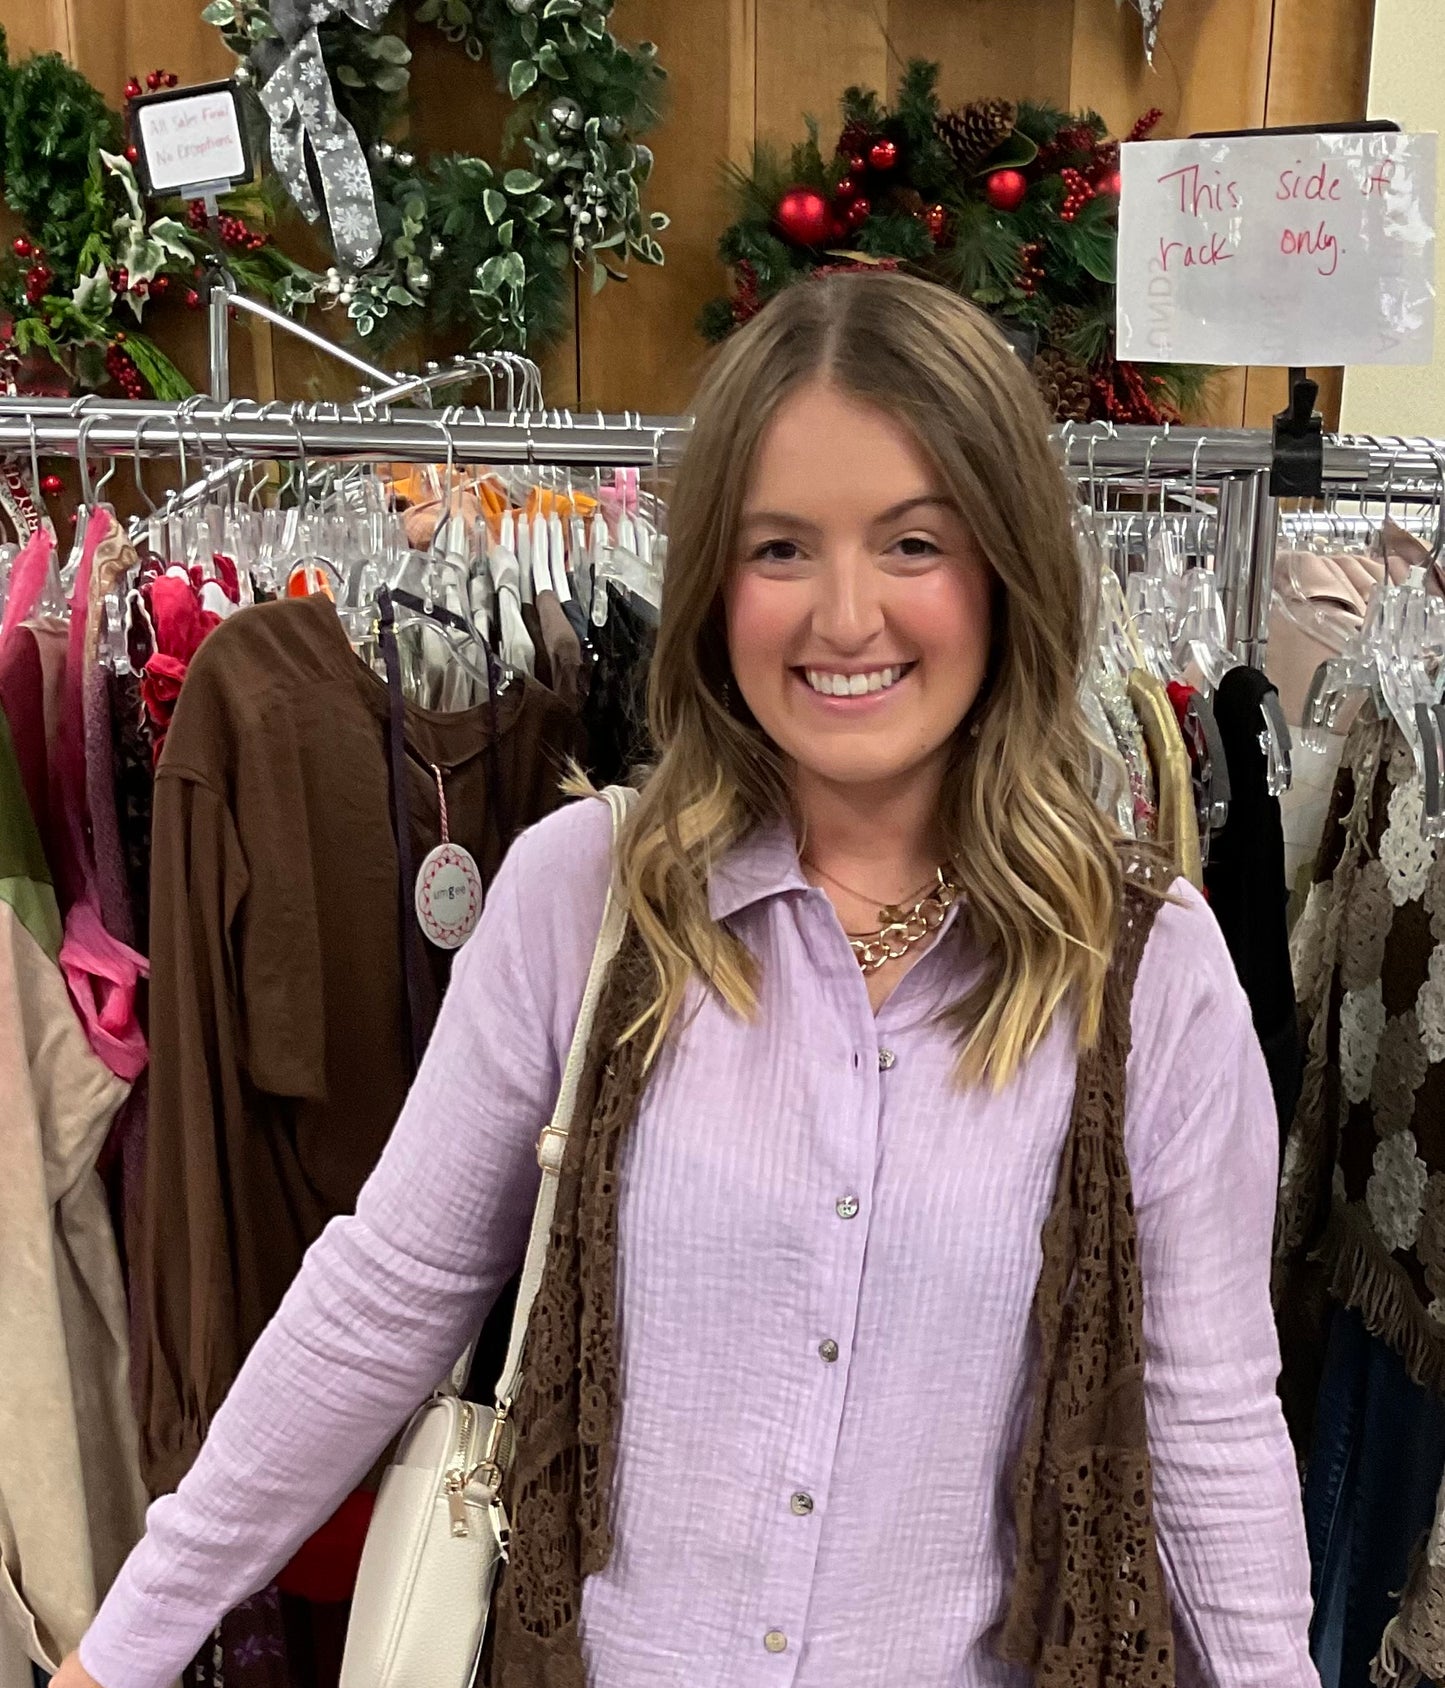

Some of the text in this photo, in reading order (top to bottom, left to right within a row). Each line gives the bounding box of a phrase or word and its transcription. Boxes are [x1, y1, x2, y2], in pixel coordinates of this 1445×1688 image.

[1157, 163, 1240, 217] This
[1276, 160, 1341, 200] side
[1159, 220, 1347, 276] rack only.
